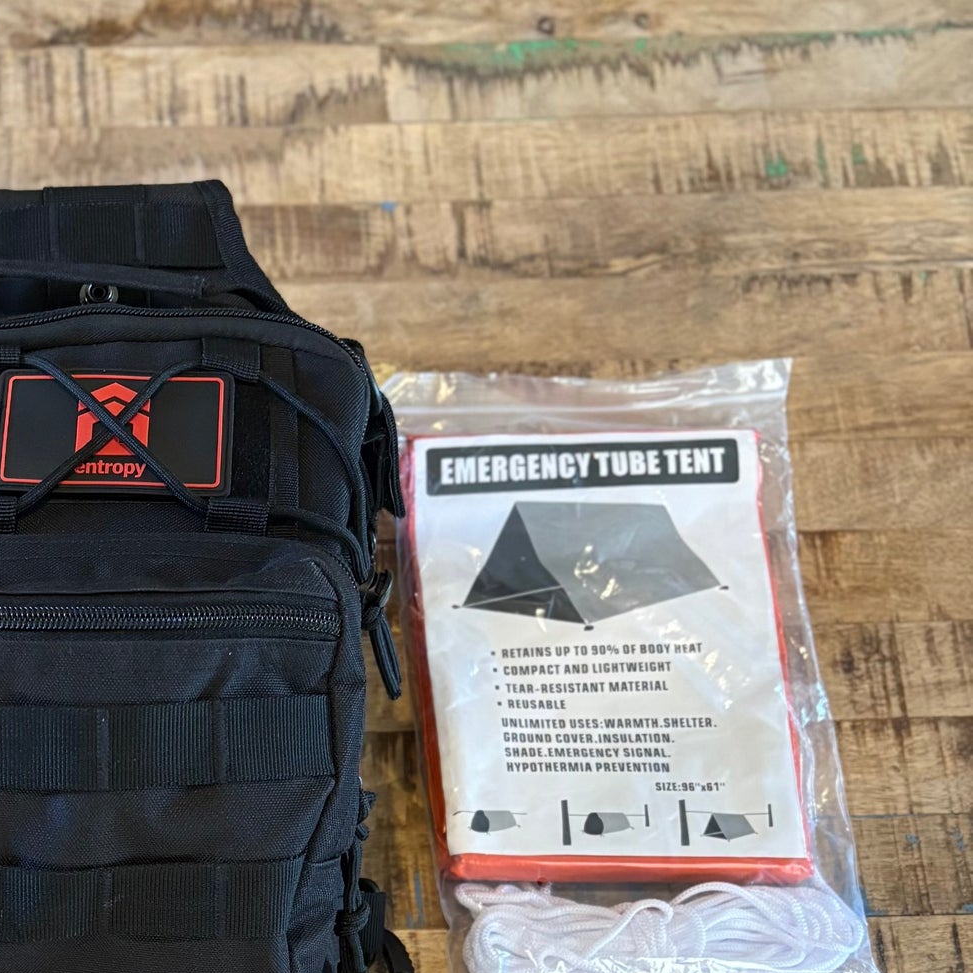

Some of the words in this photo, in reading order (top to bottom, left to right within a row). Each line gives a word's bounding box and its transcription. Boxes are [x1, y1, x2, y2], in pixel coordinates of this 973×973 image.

[74, 460, 146, 478] entropy
[440, 452, 590, 484] EMERGENCY
[593, 450, 660, 476] TUBE
[663, 447, 724, 474] TENT
[501, 646, 551, 658] RETAINS
[555, 646, 570, 656] UP
[573, 645, 587, 656] TO
[591, 644, 619, 655] 90%
[622, 644, 635, 654] OF
[674, 642, 702, 653] HEAT
[503, 664, 559, 675] COMPACT
[564, 663, 588, 674] AND
[592, 661, 670, 673] LIGHTWEIGHT
[505, 682, 604, 693] TEAR-RESISTANT
[608, 680, 668, 692] MATERIAL
[507, 699, 566, 709] REUSABLE
[501, 717, 566, 728] UNLIMITED
[503, 732, 551, 742] GROUND
[622, 747, 670, 757] SIGNAL.
[506, 761, 592, 772] HYPOTHERMIA
[595, 762, 670, 772] PREVENTION
